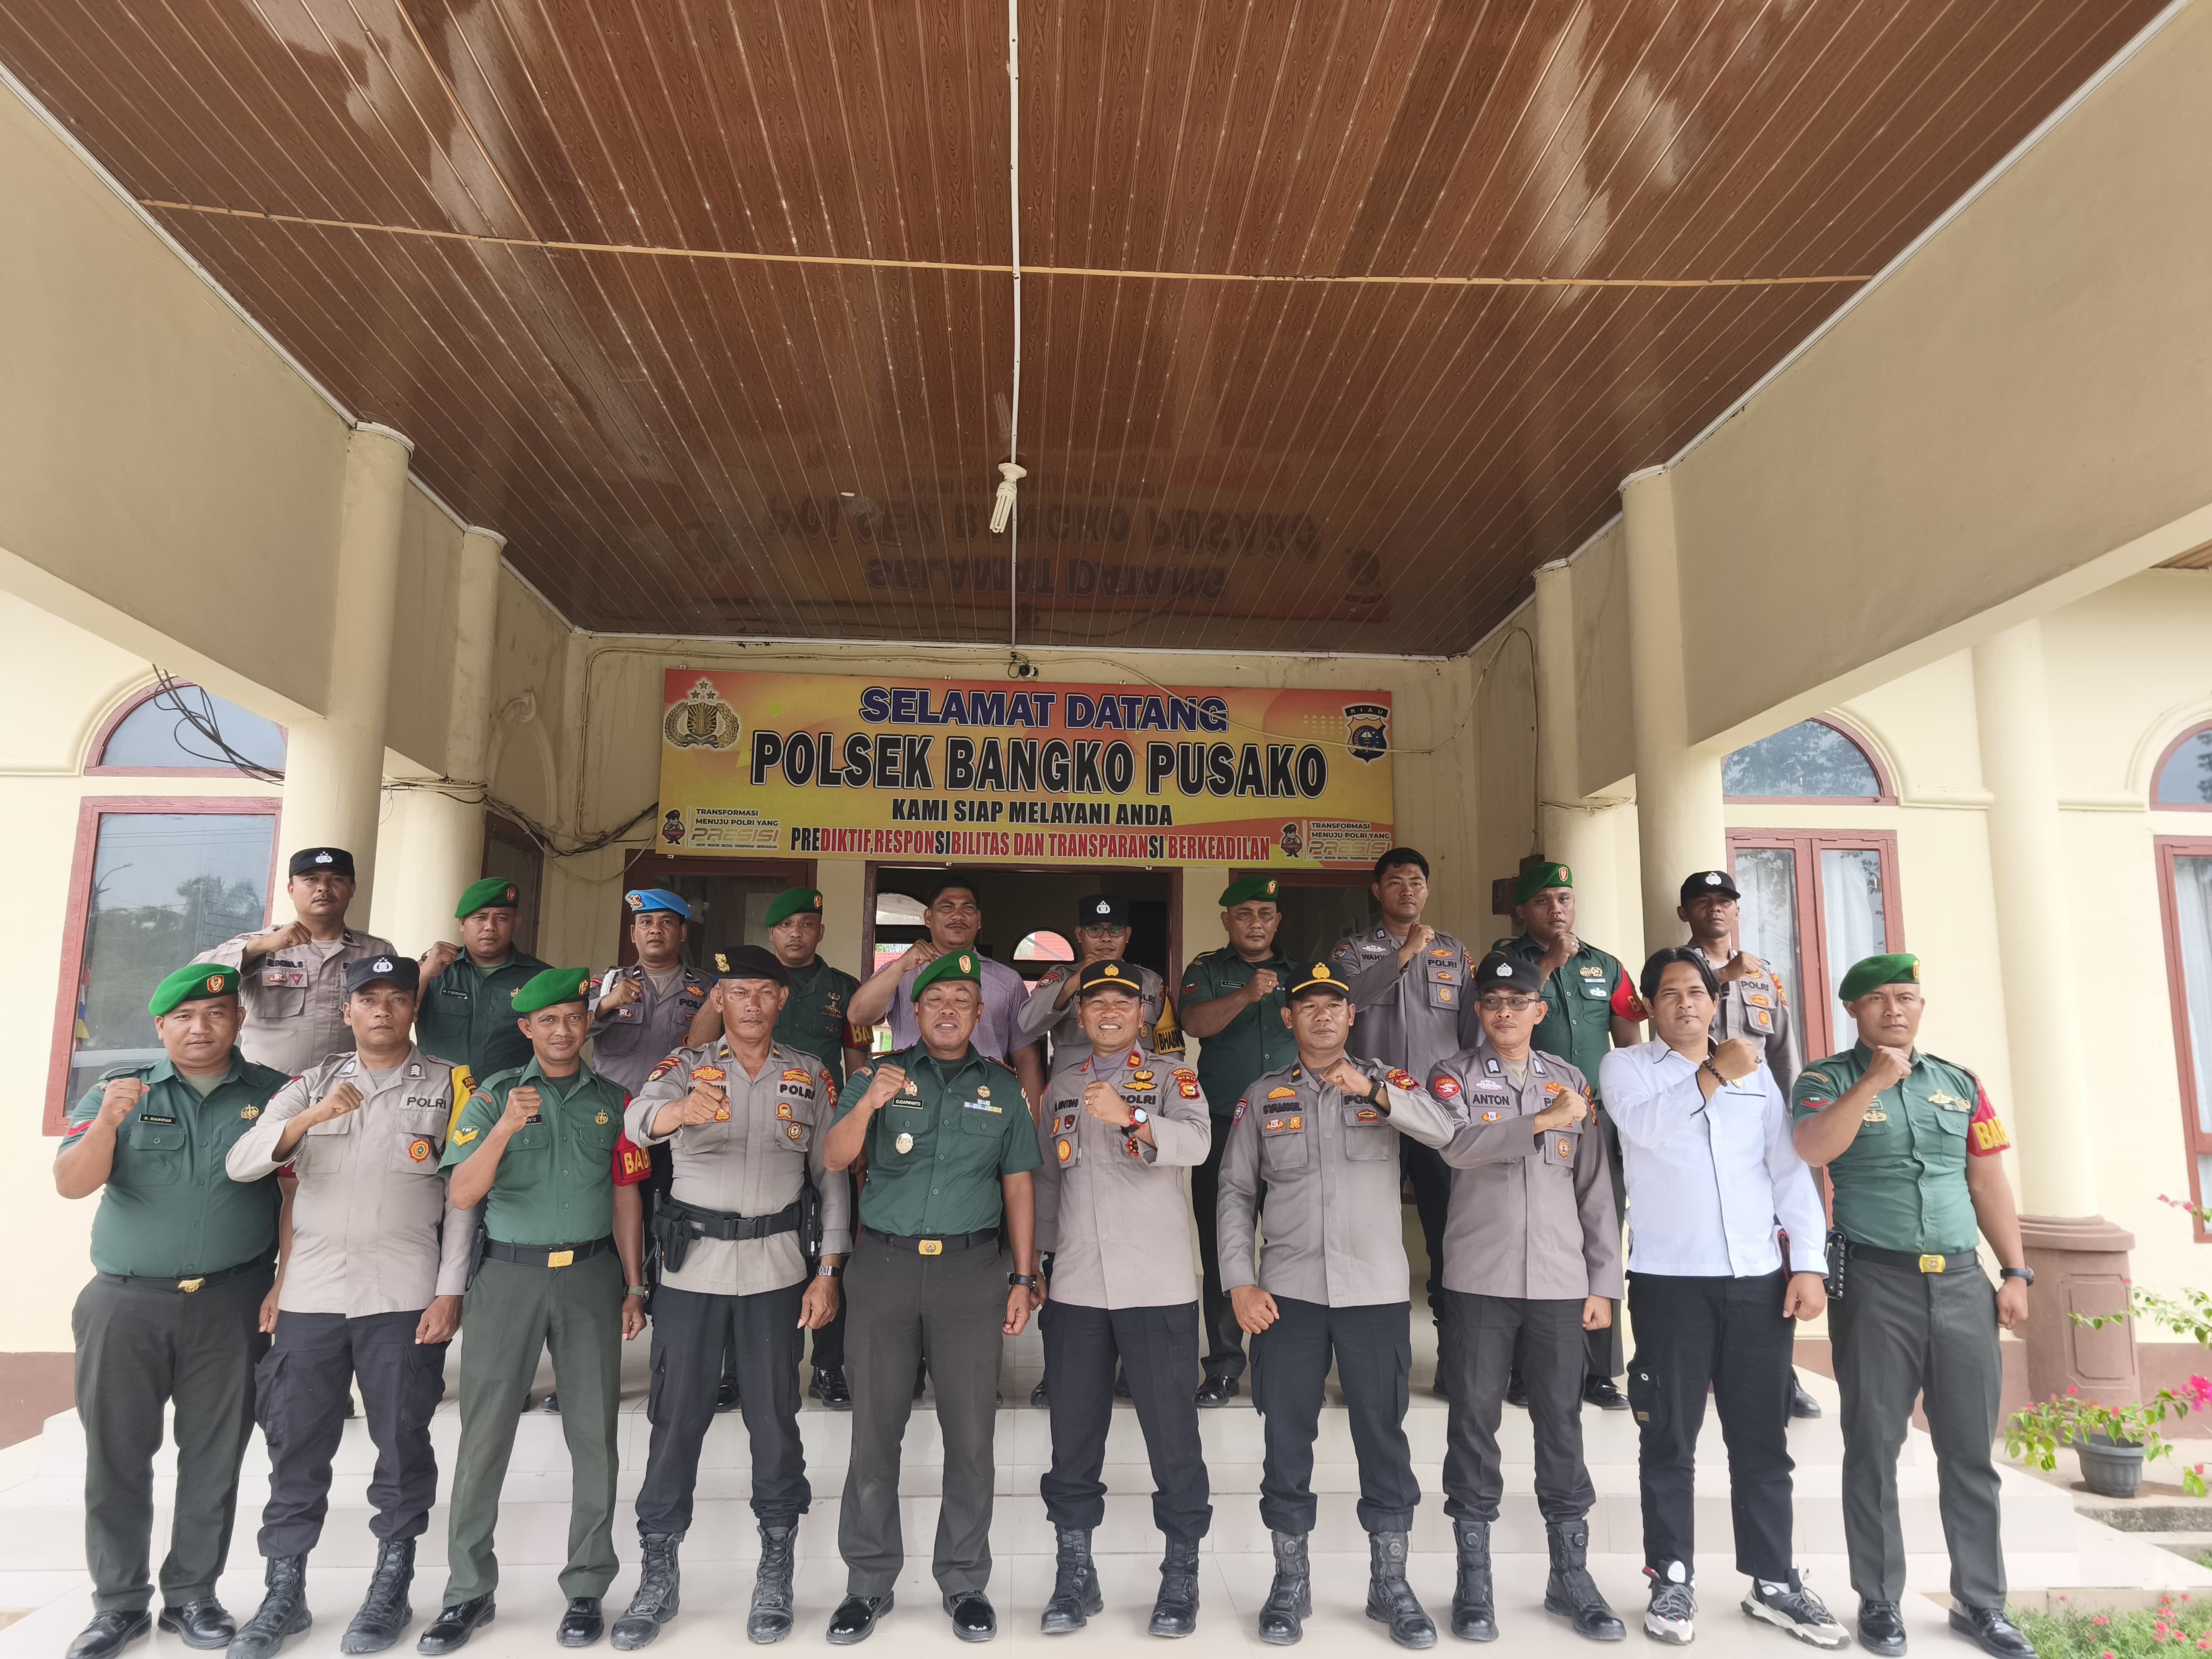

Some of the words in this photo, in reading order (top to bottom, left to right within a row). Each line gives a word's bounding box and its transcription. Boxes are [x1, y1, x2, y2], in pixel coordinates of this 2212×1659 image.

[859, 686, 1056, 728] SELAMAT
[1065, 694, 1228, 733] DATANG
[751, 730, 935, 791] POLSEK
[946, 736, 1135, 795] BANGKO
[1148, 742, 1328, 799] PUSAKO
[892, 798, 947, 821] KAMI
[954, 800, 1003, 822] SIAP
[1008, 801, 1110, 825] MELAYANI
[1116, 804, 1173, 826] ANDA
[691, 827, 780, 842] PRESISI
[1014, 834, 1044, 857] DAN
[1049, 833, 1164, 859] TRANSPARANSI
[1168, 835, 1271, 861] BERKEADILAN
[1309, 840, 1392, 855] PRESISI
[1428, 959, 1458, 968] POLRI
[1741, 980, 1769, 992] POLRI
[679, 998, 703, 1009] POL
[1140, 993, 1156, 1003] LRI
[780, 1084, 815, 1101] POLRI
[1473, 1094, 1510, 1106] ANTON
[407, 1097, 447, 1109] POLRI
